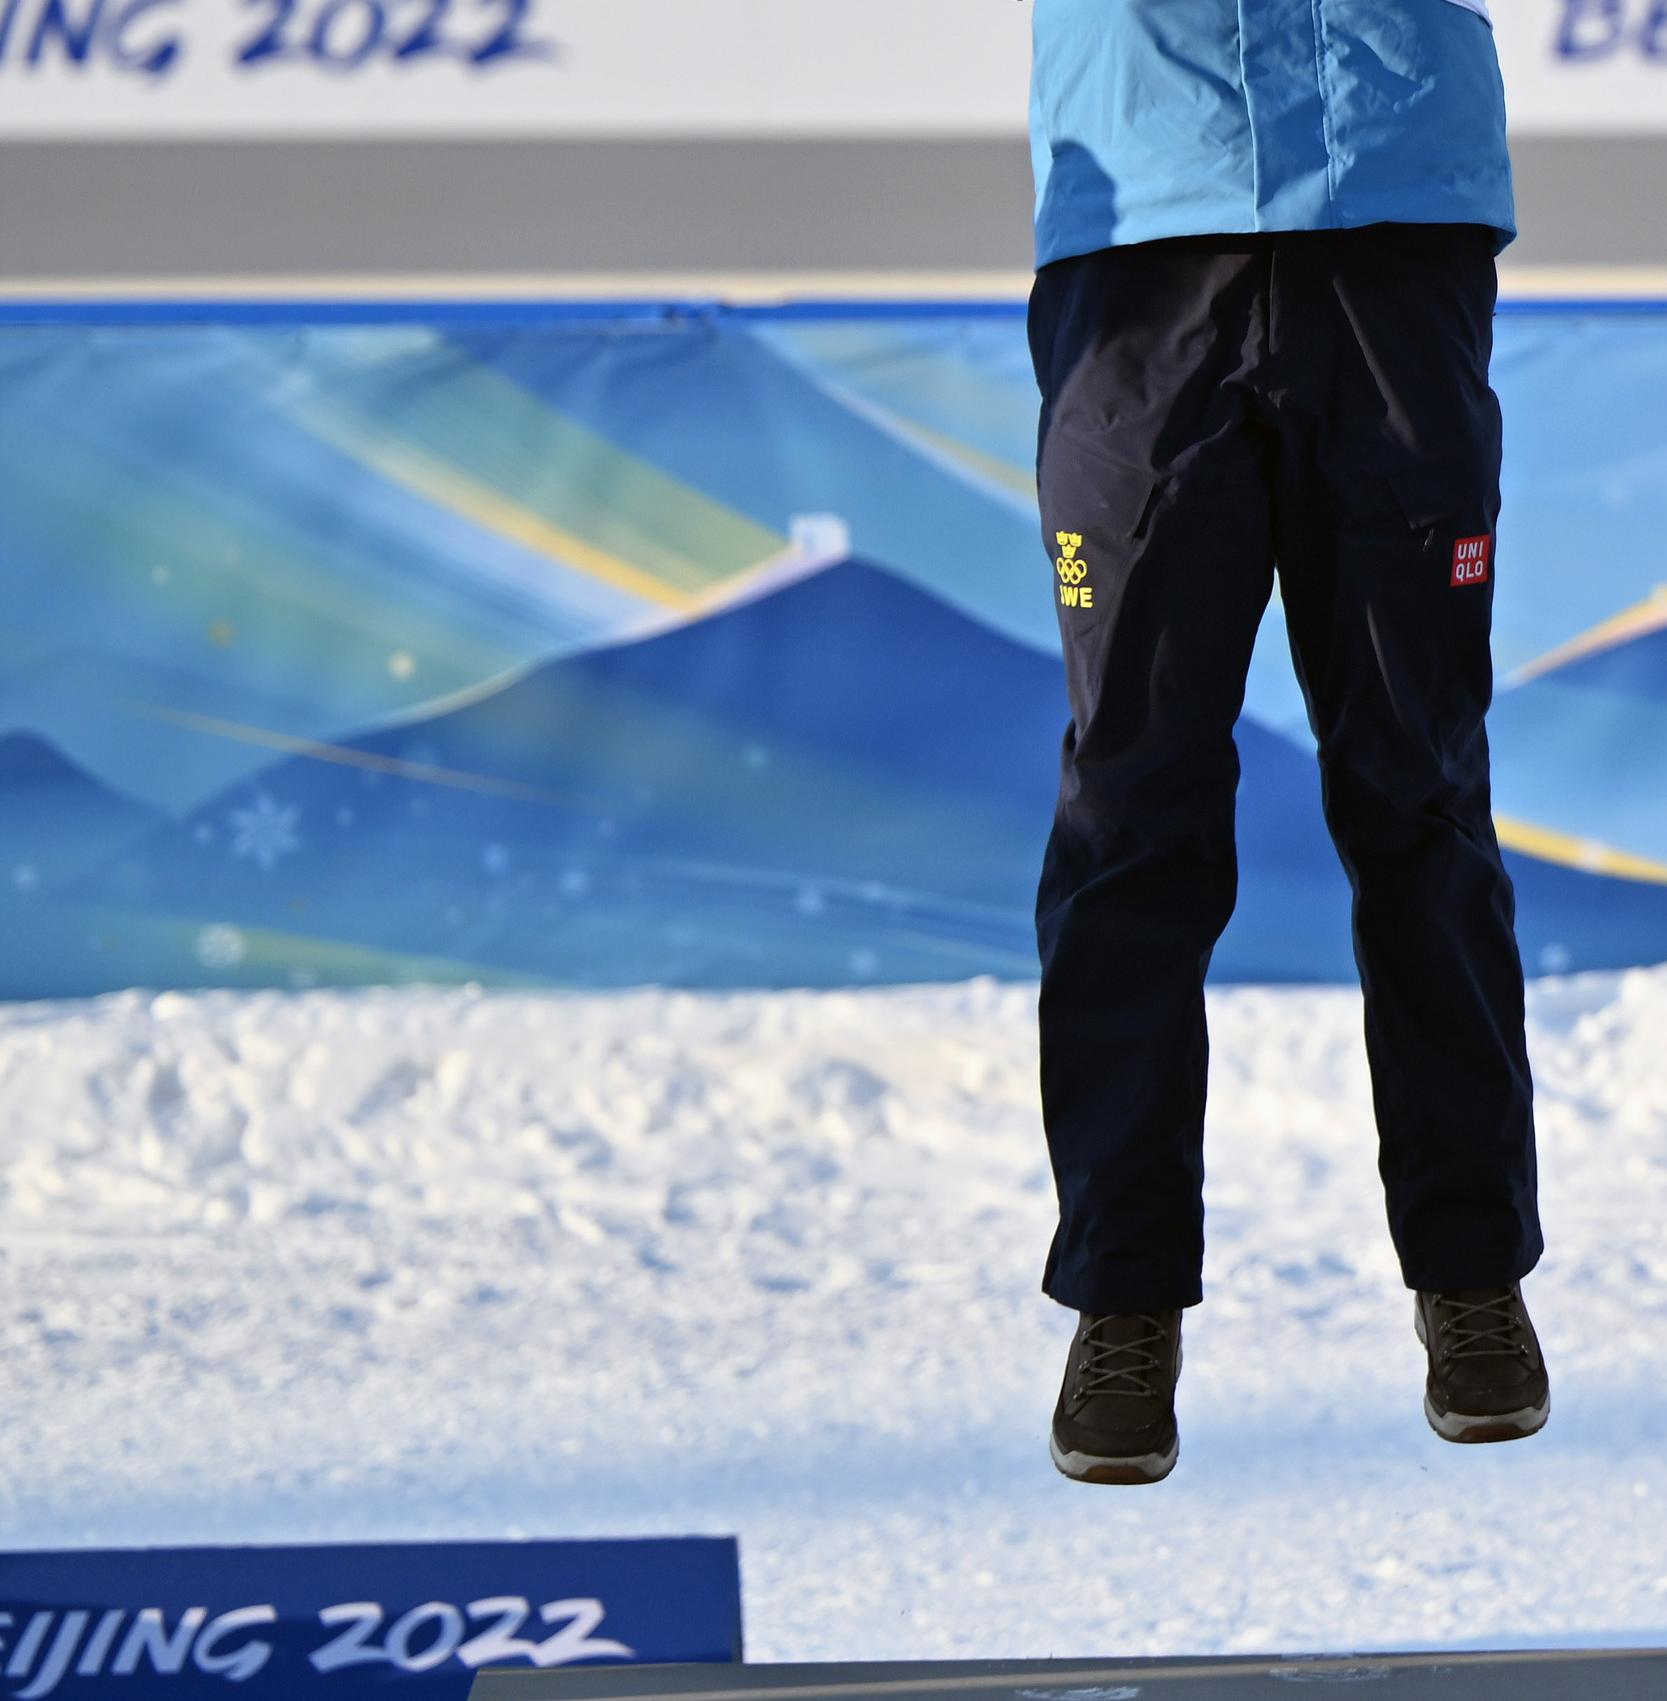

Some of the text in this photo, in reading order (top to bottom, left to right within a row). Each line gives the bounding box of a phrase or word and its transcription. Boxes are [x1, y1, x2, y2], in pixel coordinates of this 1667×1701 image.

[1457, 540, 1484, 560] UNI
[1455, 560, 1484, 582] QLO
[0, 1597, 635, 1700] IJING 2022
